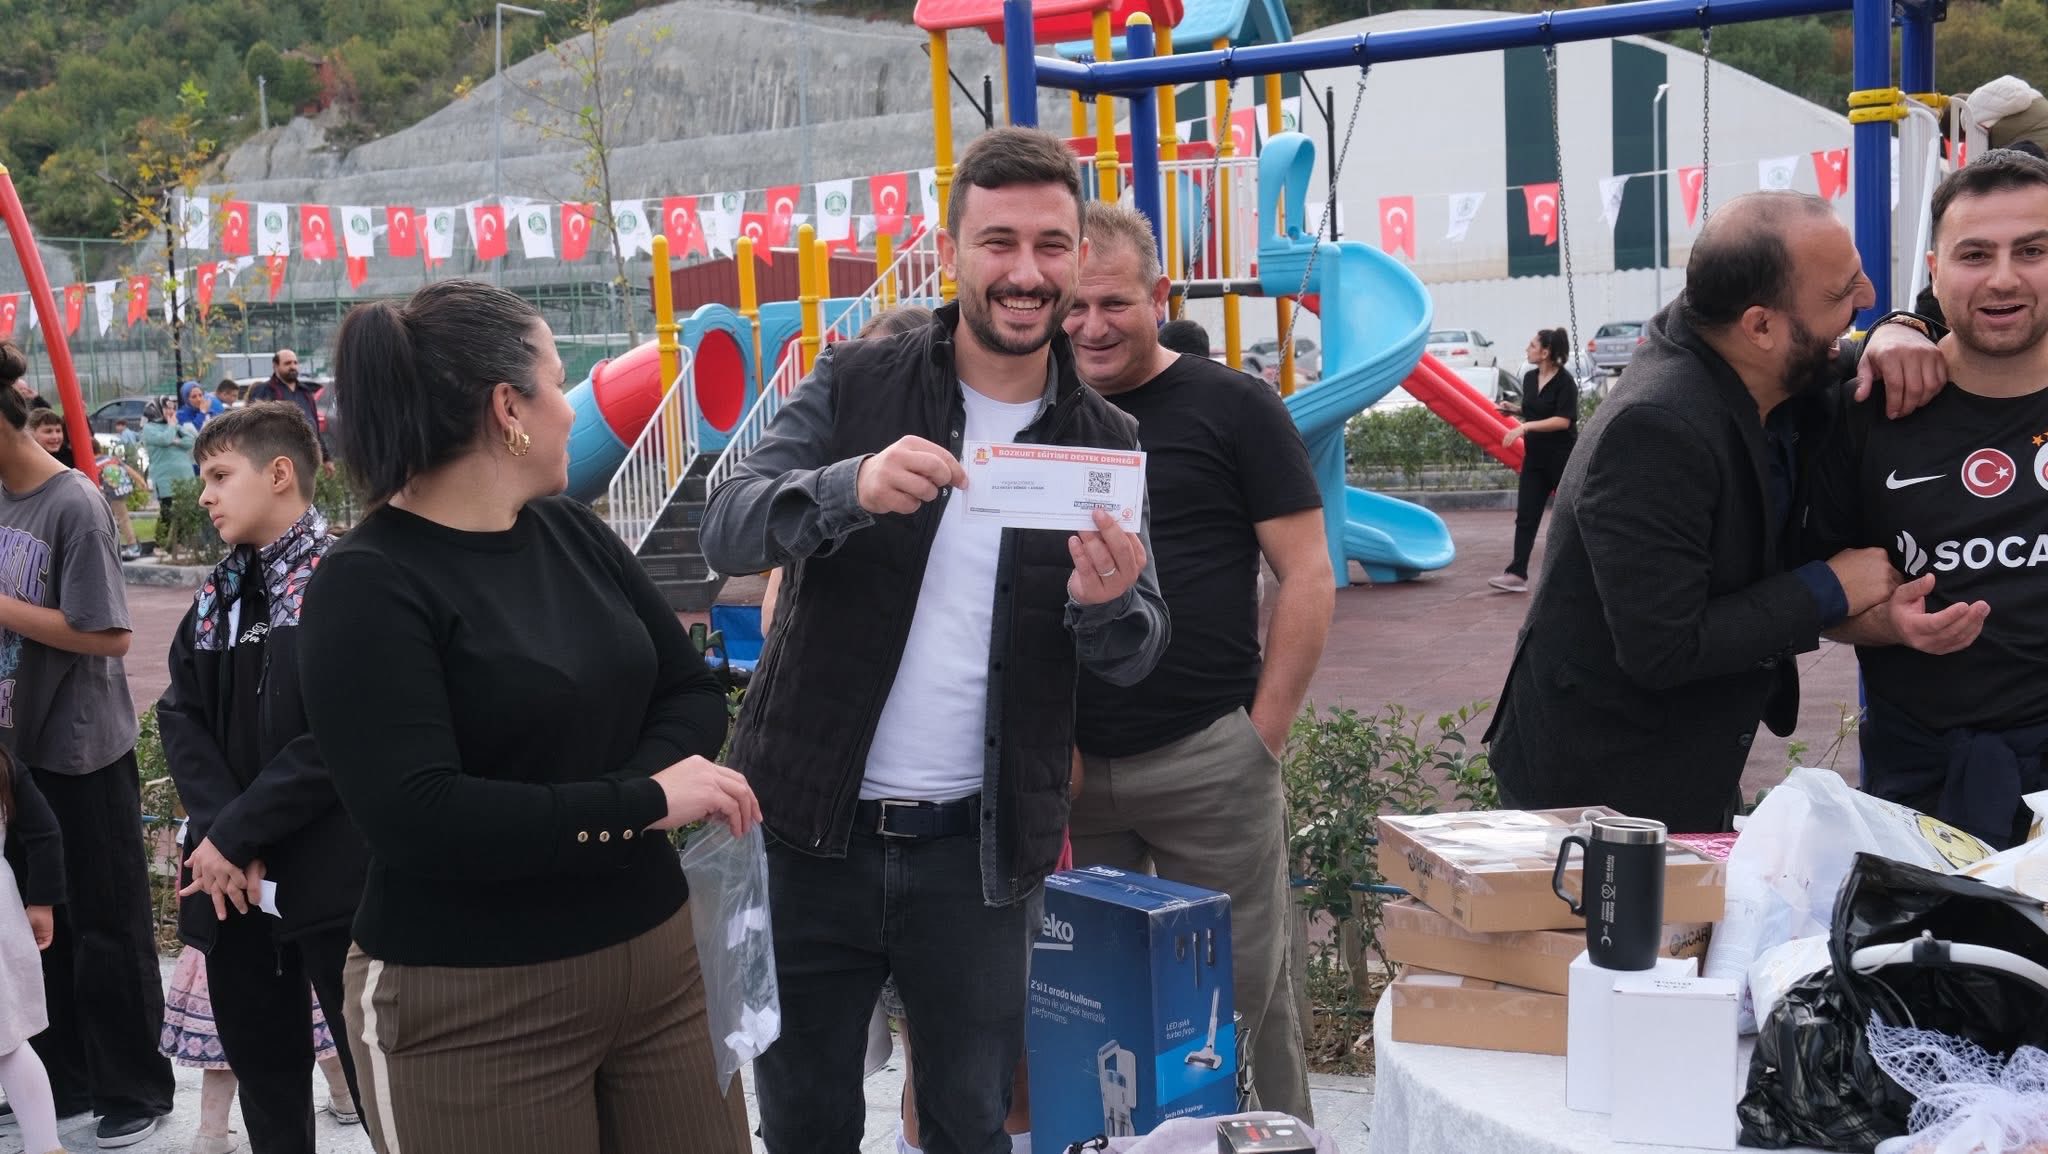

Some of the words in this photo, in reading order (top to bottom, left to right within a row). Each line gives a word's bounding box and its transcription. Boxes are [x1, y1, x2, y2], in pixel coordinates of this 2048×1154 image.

[998, 449, 1034, 458] BOZKURT
[1037, 451, 1069, 460] EĞİTİME
[1070, 453, 1100, 462] DESTEK
[1100, 455, 1134, 465] DERNEĞİ
[1932, 533, 2048, 572] SOCA
[1042, 912, 1074, 943] eko
[1030, 979, 1043, 992] 2'si
[1043, 983, 1048, 993] 1
[1048, 987, 1070, 1000] arada
[1070, 991, 1102, 1010] kullanım
[1166, 1021, 1178, 1031] LED
